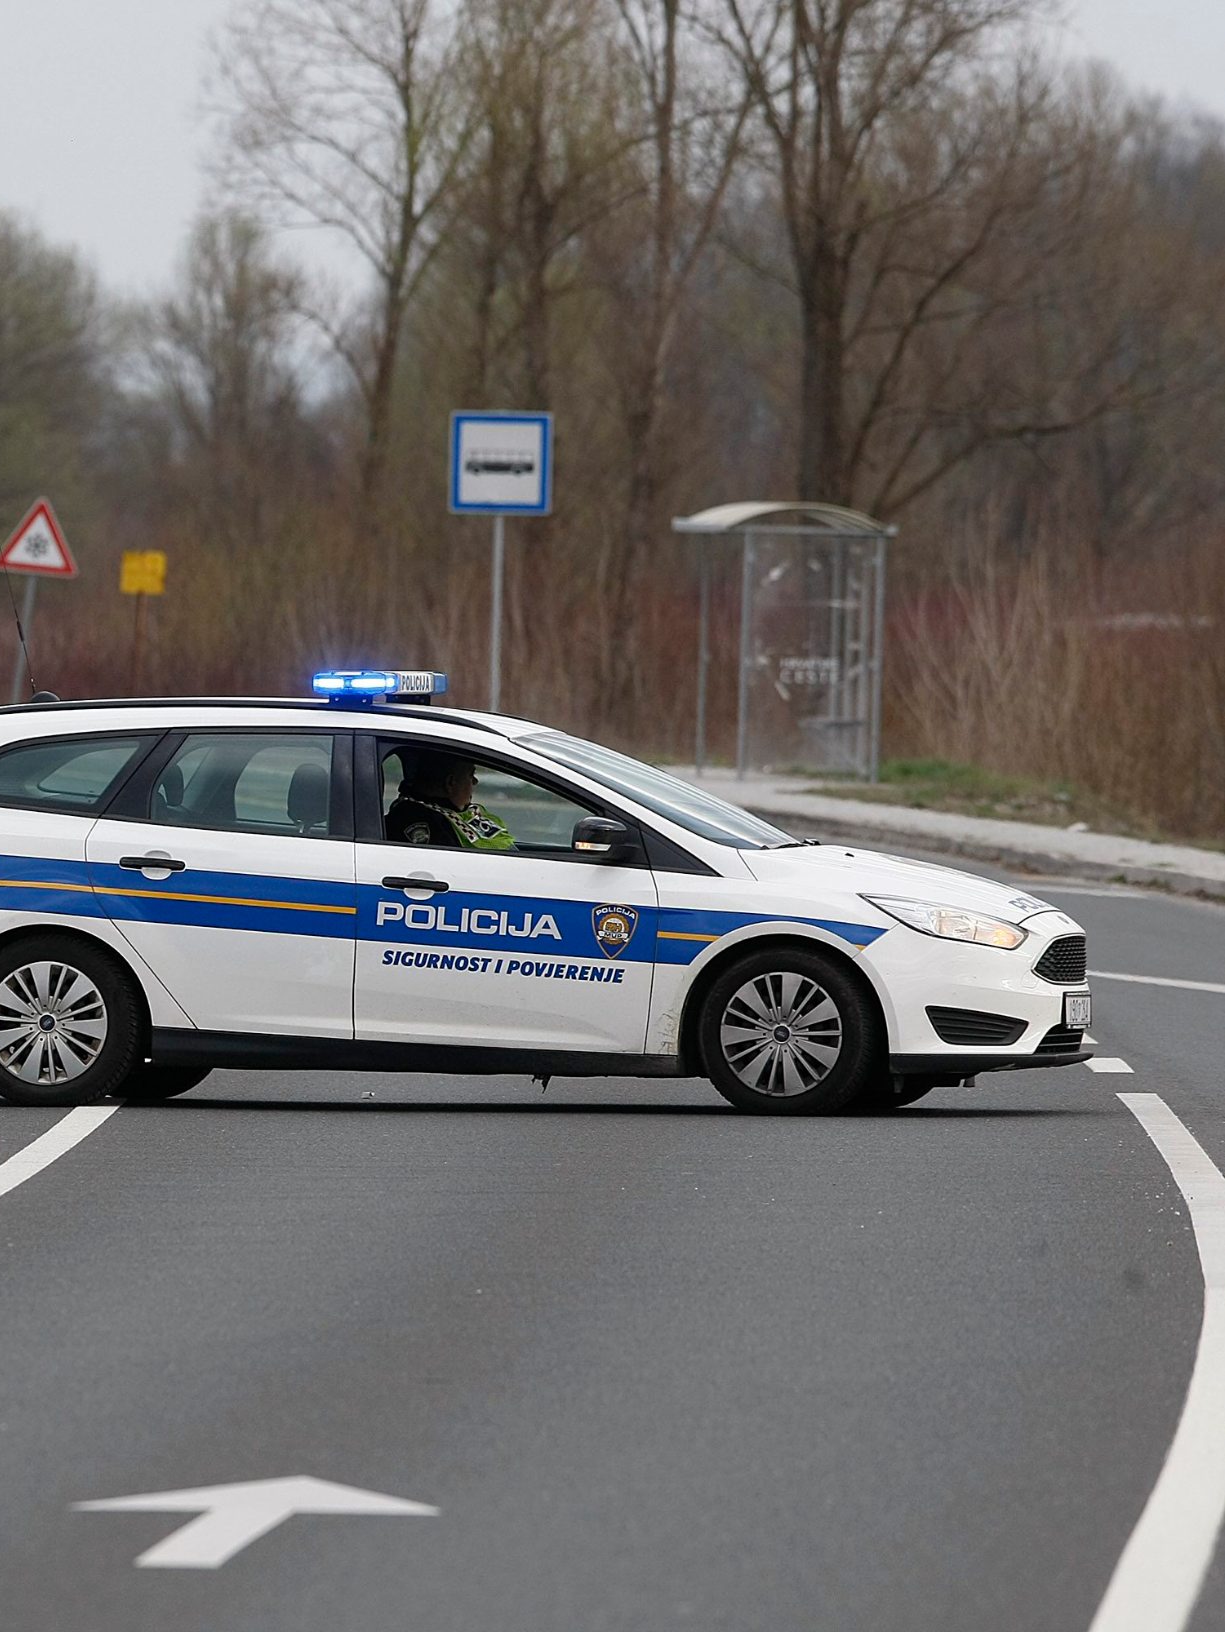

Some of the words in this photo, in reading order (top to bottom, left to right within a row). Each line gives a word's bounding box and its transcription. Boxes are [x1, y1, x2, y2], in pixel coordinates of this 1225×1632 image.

[401, 674, 430, 691] POLICIJA
[376, 901, 562, 940] POLICIJA
[596, 907, 636, 920] POLICIJA
[382, 950, 492, 973] SIGURNOST
[494, 959, 504, 974] I
[506, 960, 625, 983] POVJERENJE
